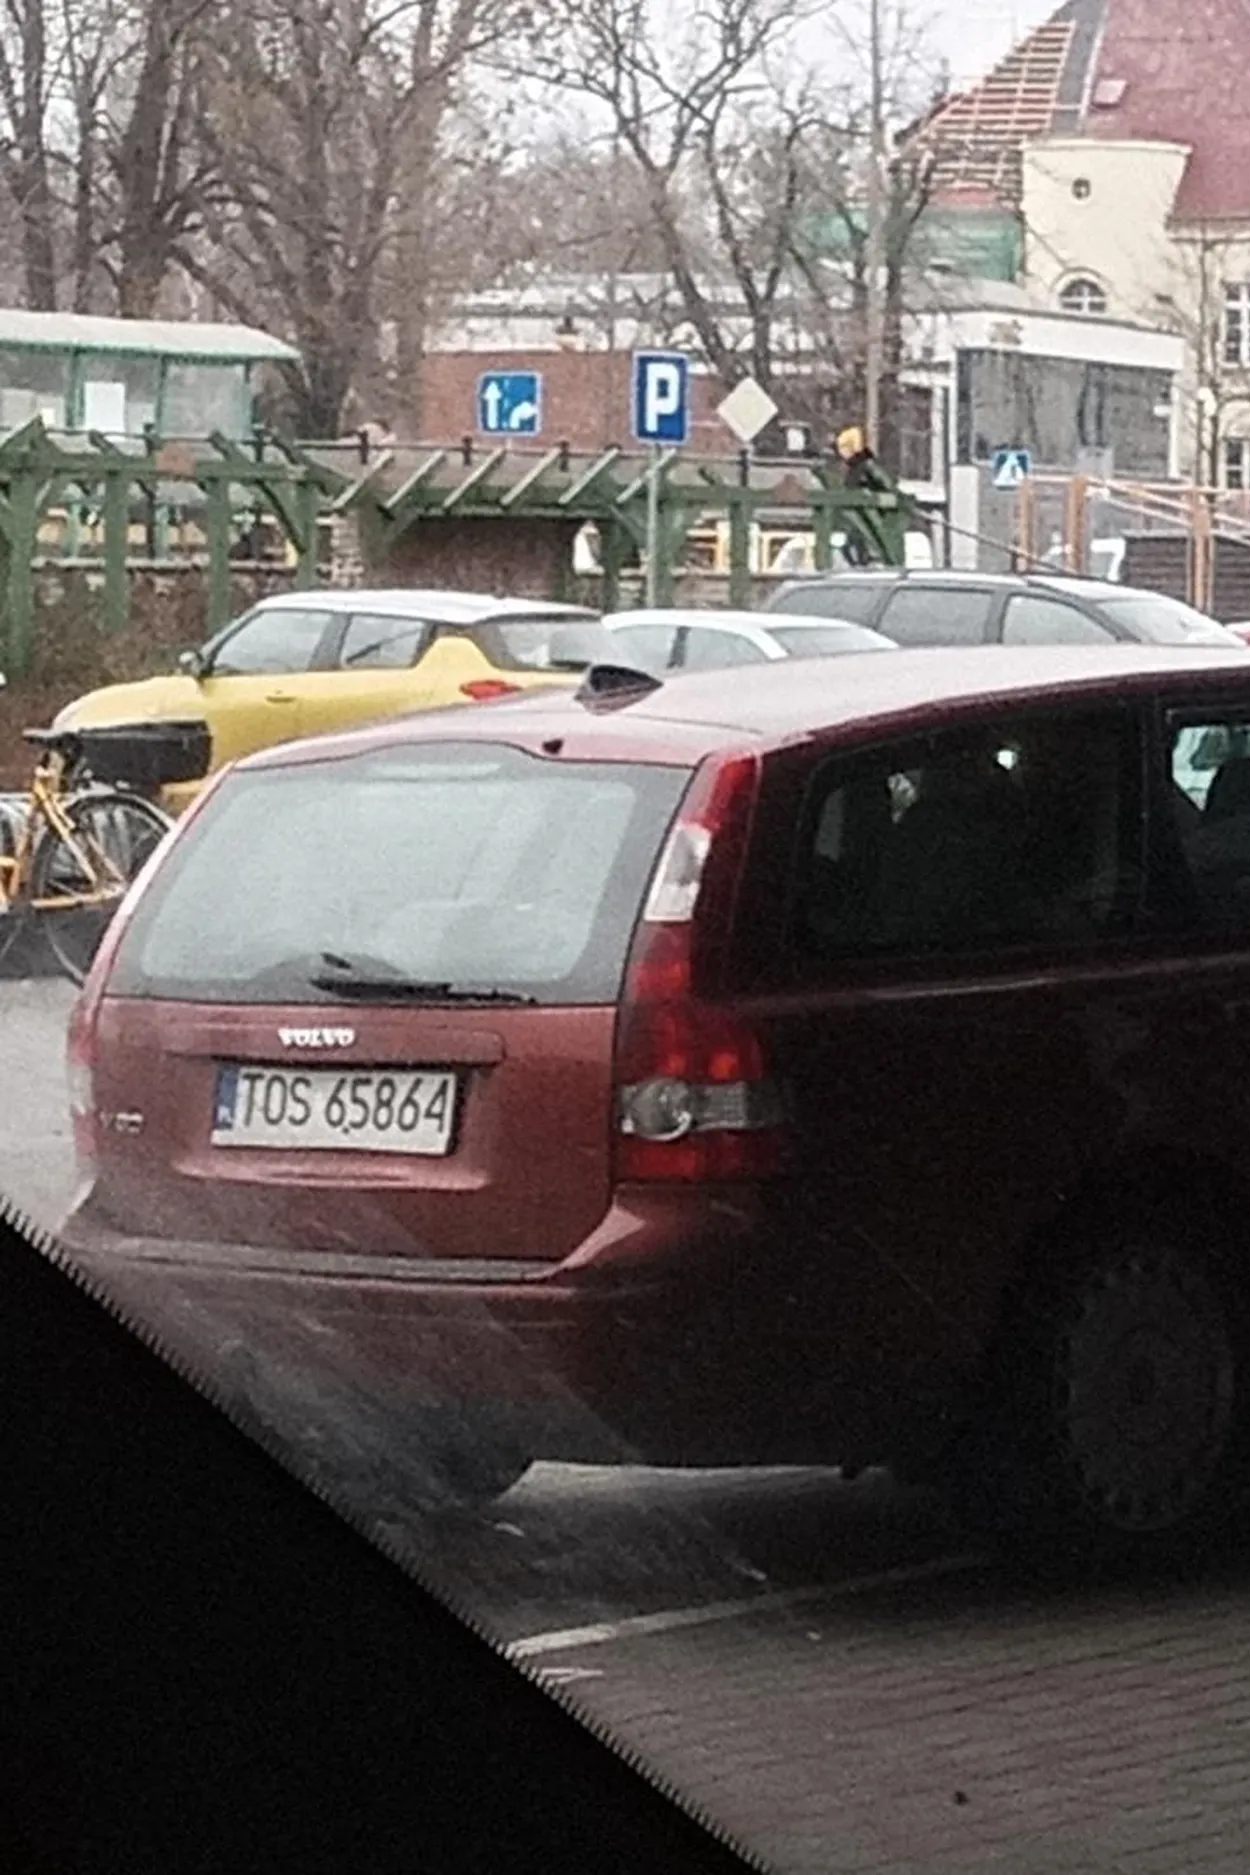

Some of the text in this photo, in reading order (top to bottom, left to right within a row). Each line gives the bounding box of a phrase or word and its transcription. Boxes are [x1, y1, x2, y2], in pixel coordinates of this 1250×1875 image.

[646, 363, 681, 431] P
[278, 1028, 355, 1046] VOLVO
[242, 1072, 449, 1134] TOS 65864
